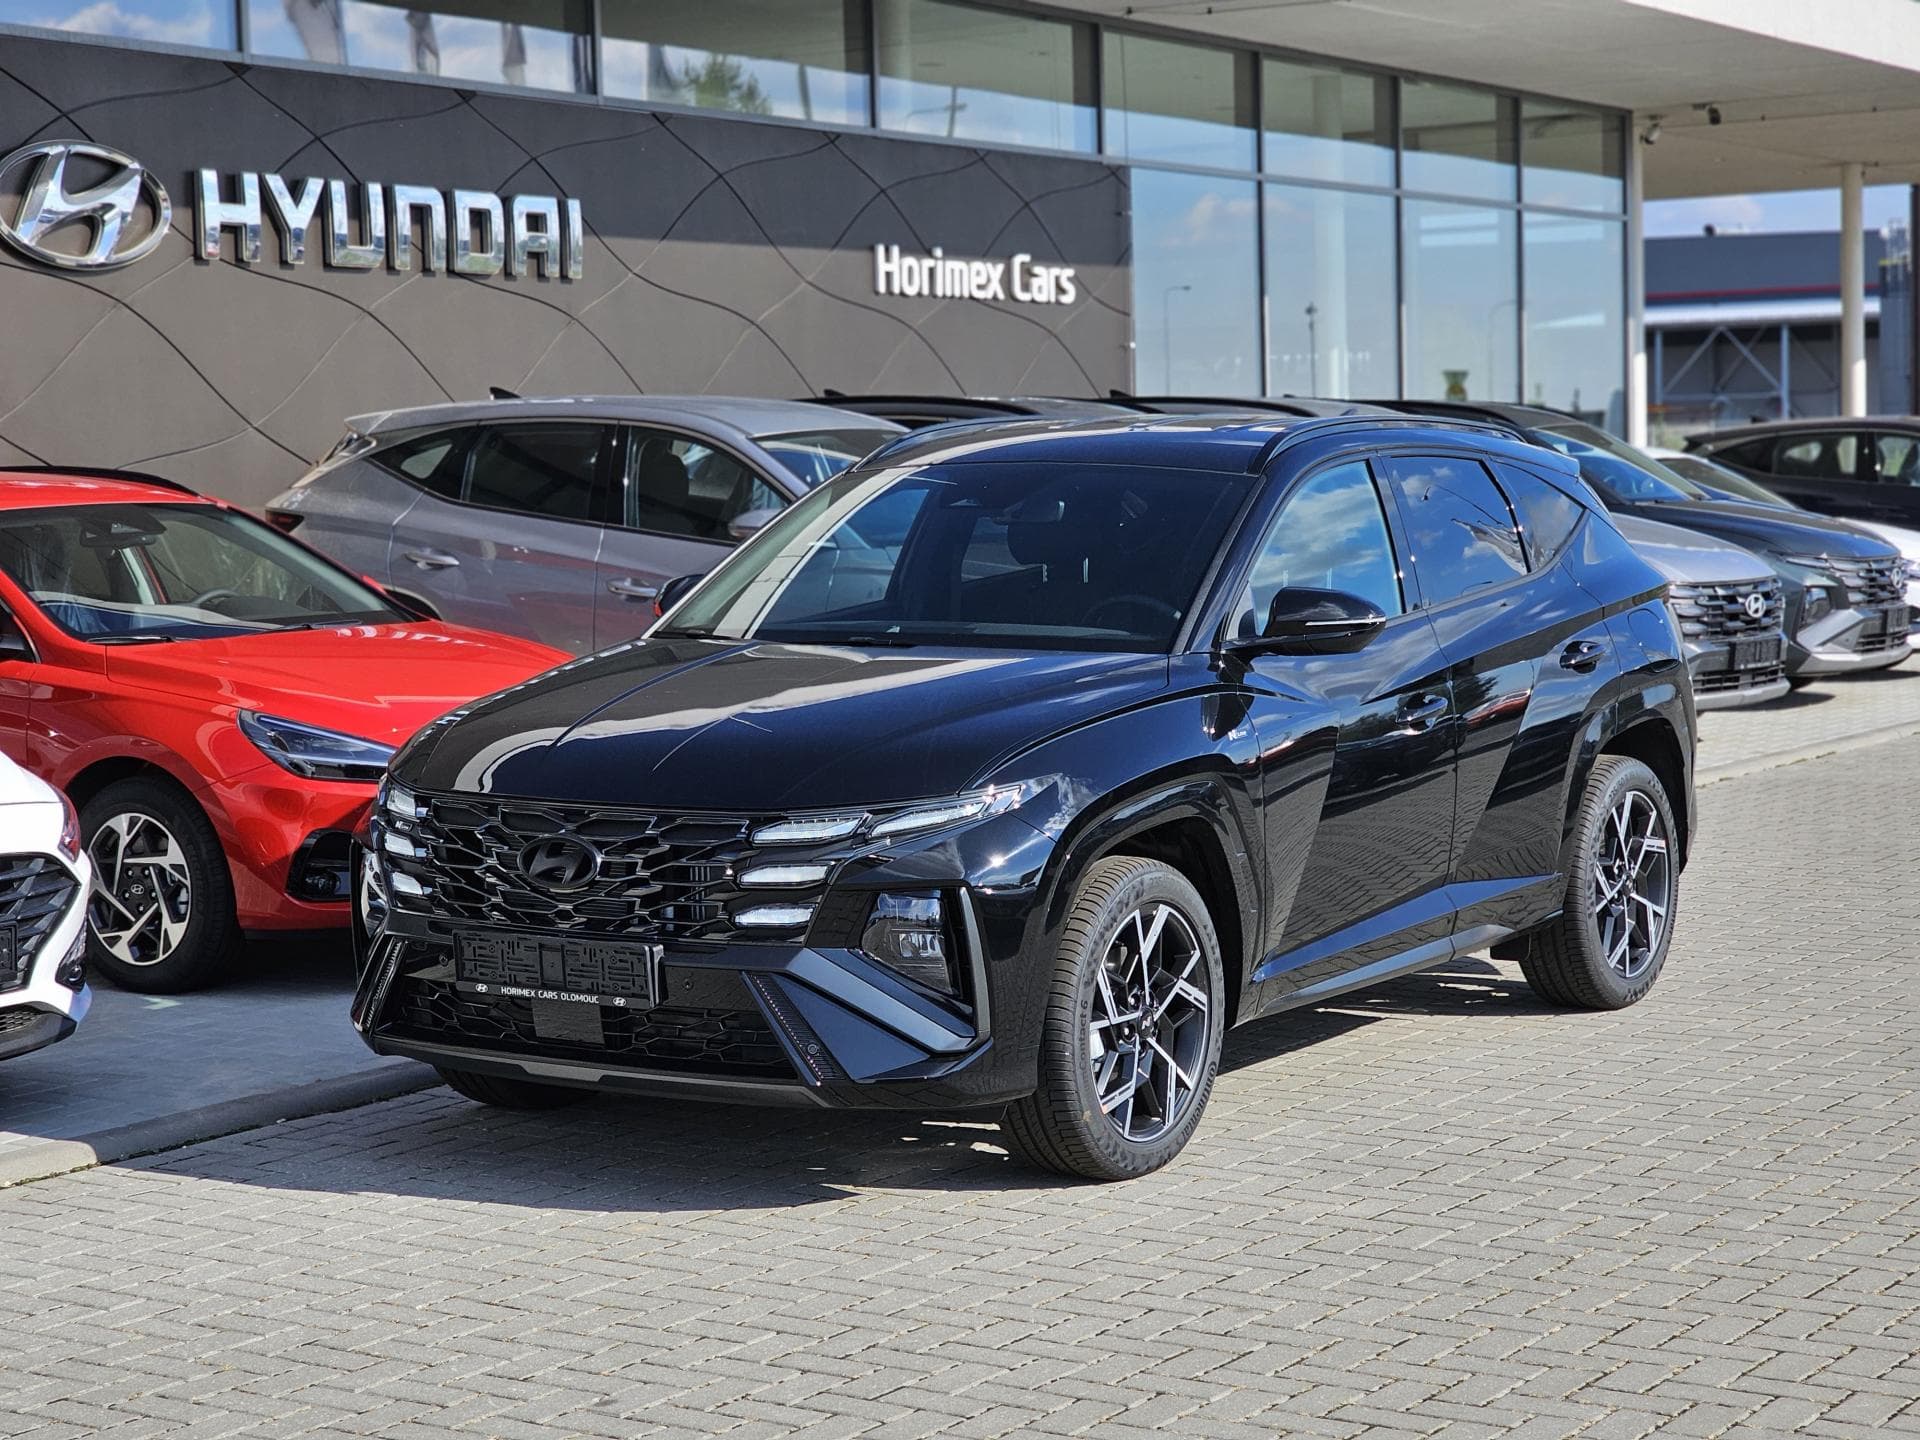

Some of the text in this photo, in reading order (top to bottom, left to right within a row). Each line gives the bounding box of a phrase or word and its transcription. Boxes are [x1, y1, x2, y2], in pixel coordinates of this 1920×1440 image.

[196, 168, 584, 280] HYUNDAI
[873, 243, 1077, 304] Horimex Cars
[501, 987, 599, 1004] HORIMEX CARS OLOMOUC
